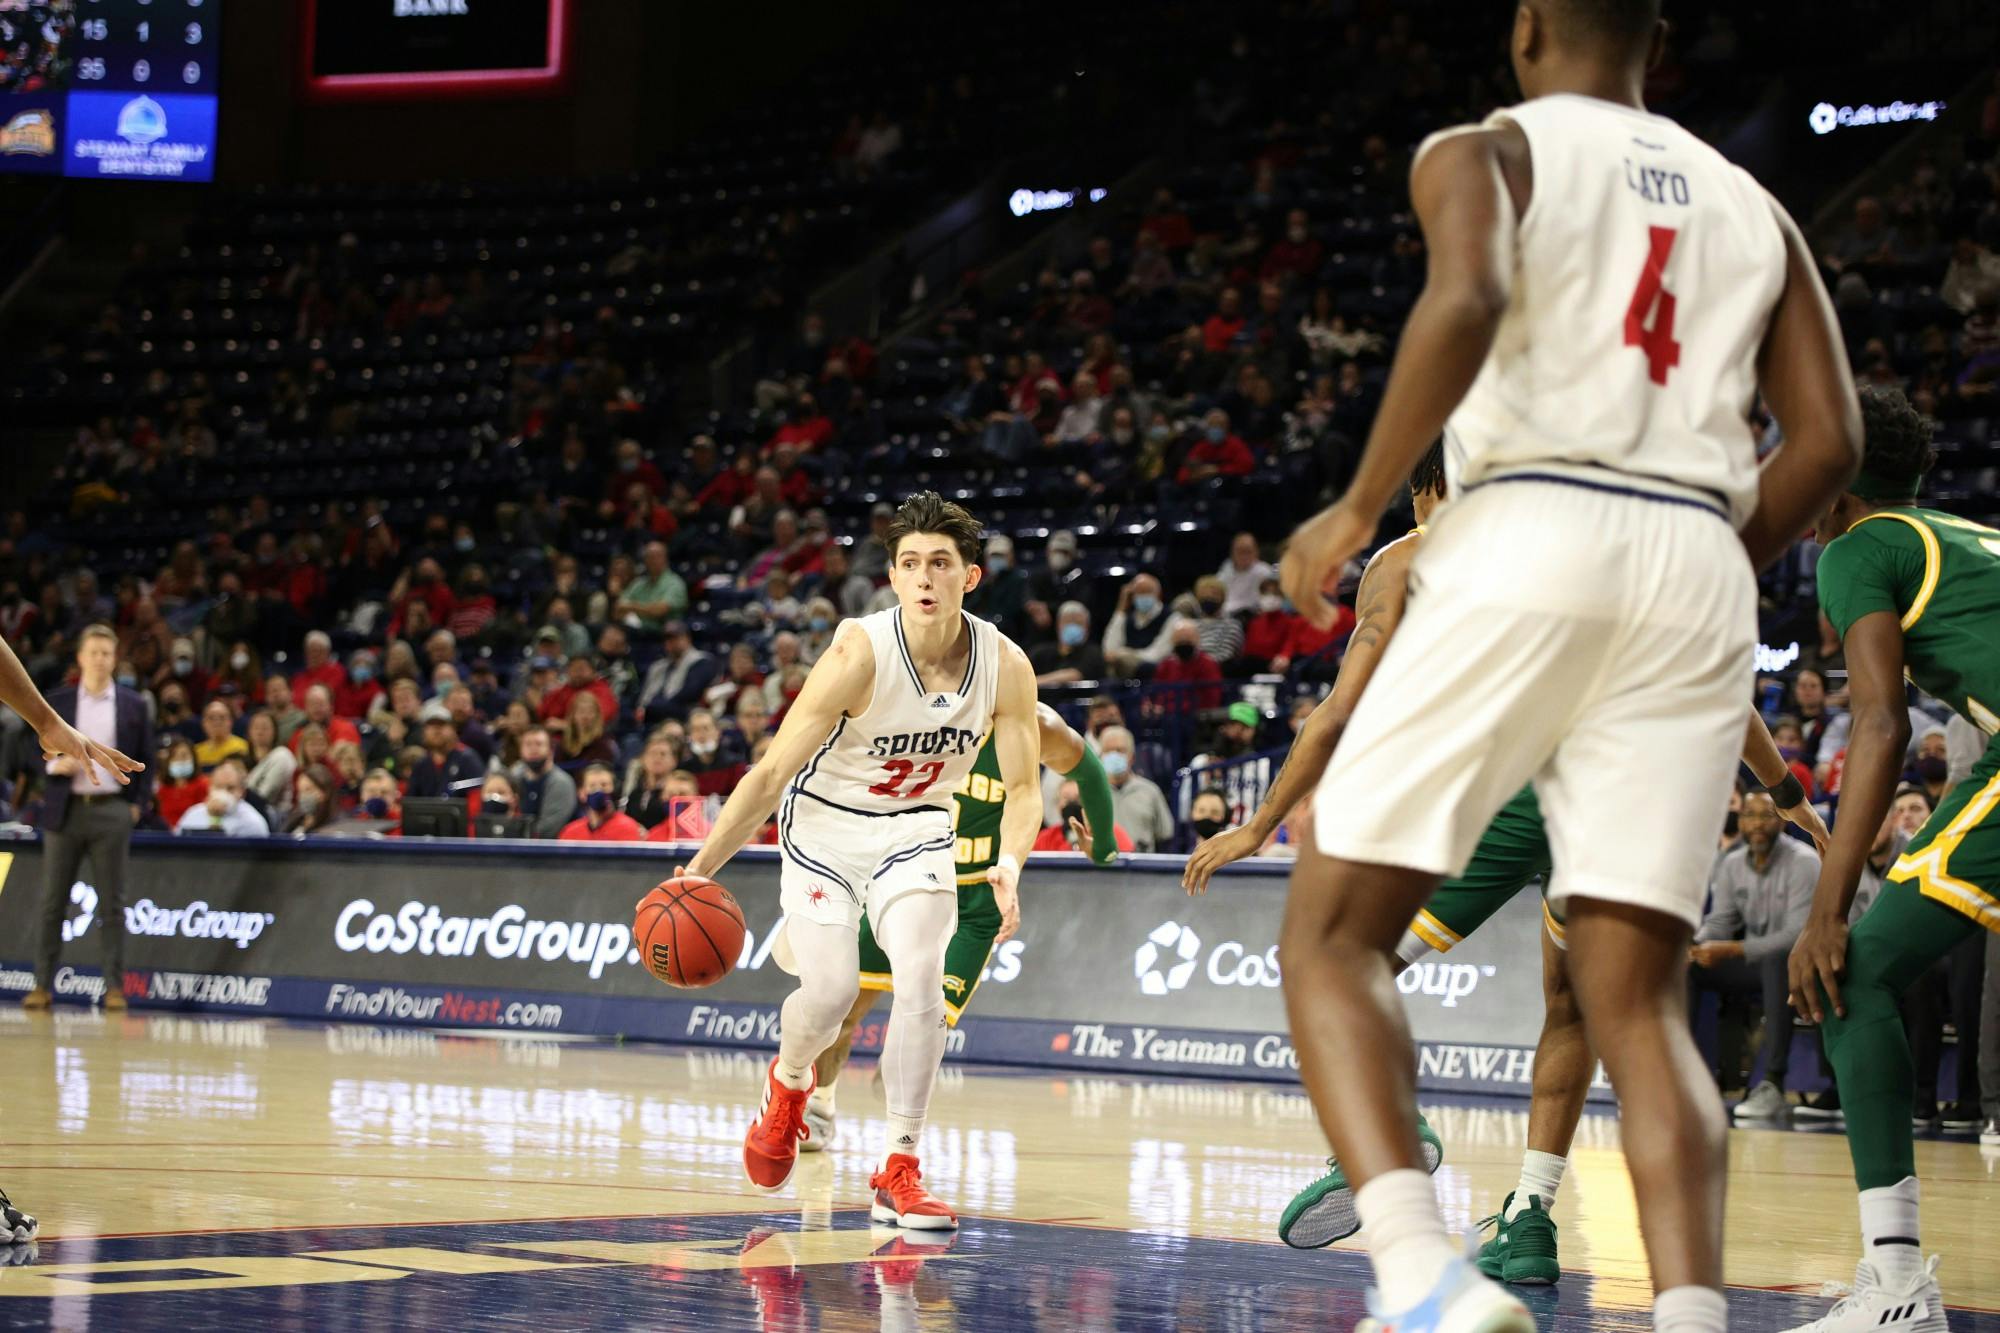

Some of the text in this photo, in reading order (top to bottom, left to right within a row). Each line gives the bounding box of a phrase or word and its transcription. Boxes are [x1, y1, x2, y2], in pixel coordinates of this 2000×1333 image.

[81, 18, 108, 41] 15
[136, 20, 150, 42] 1
[77, 57, 106, 80] 35
[1624, 224, 1681, 387] 4
[124, 898, 265, 949] StarGroup
[325, 983, 563, 1028] FindYourNest.com
[1072, 1024, 1123, 1059] The
[1129, 1027, 1247, 1067] Yeatman
[1253, 1035, 1301, 1071] Gro
